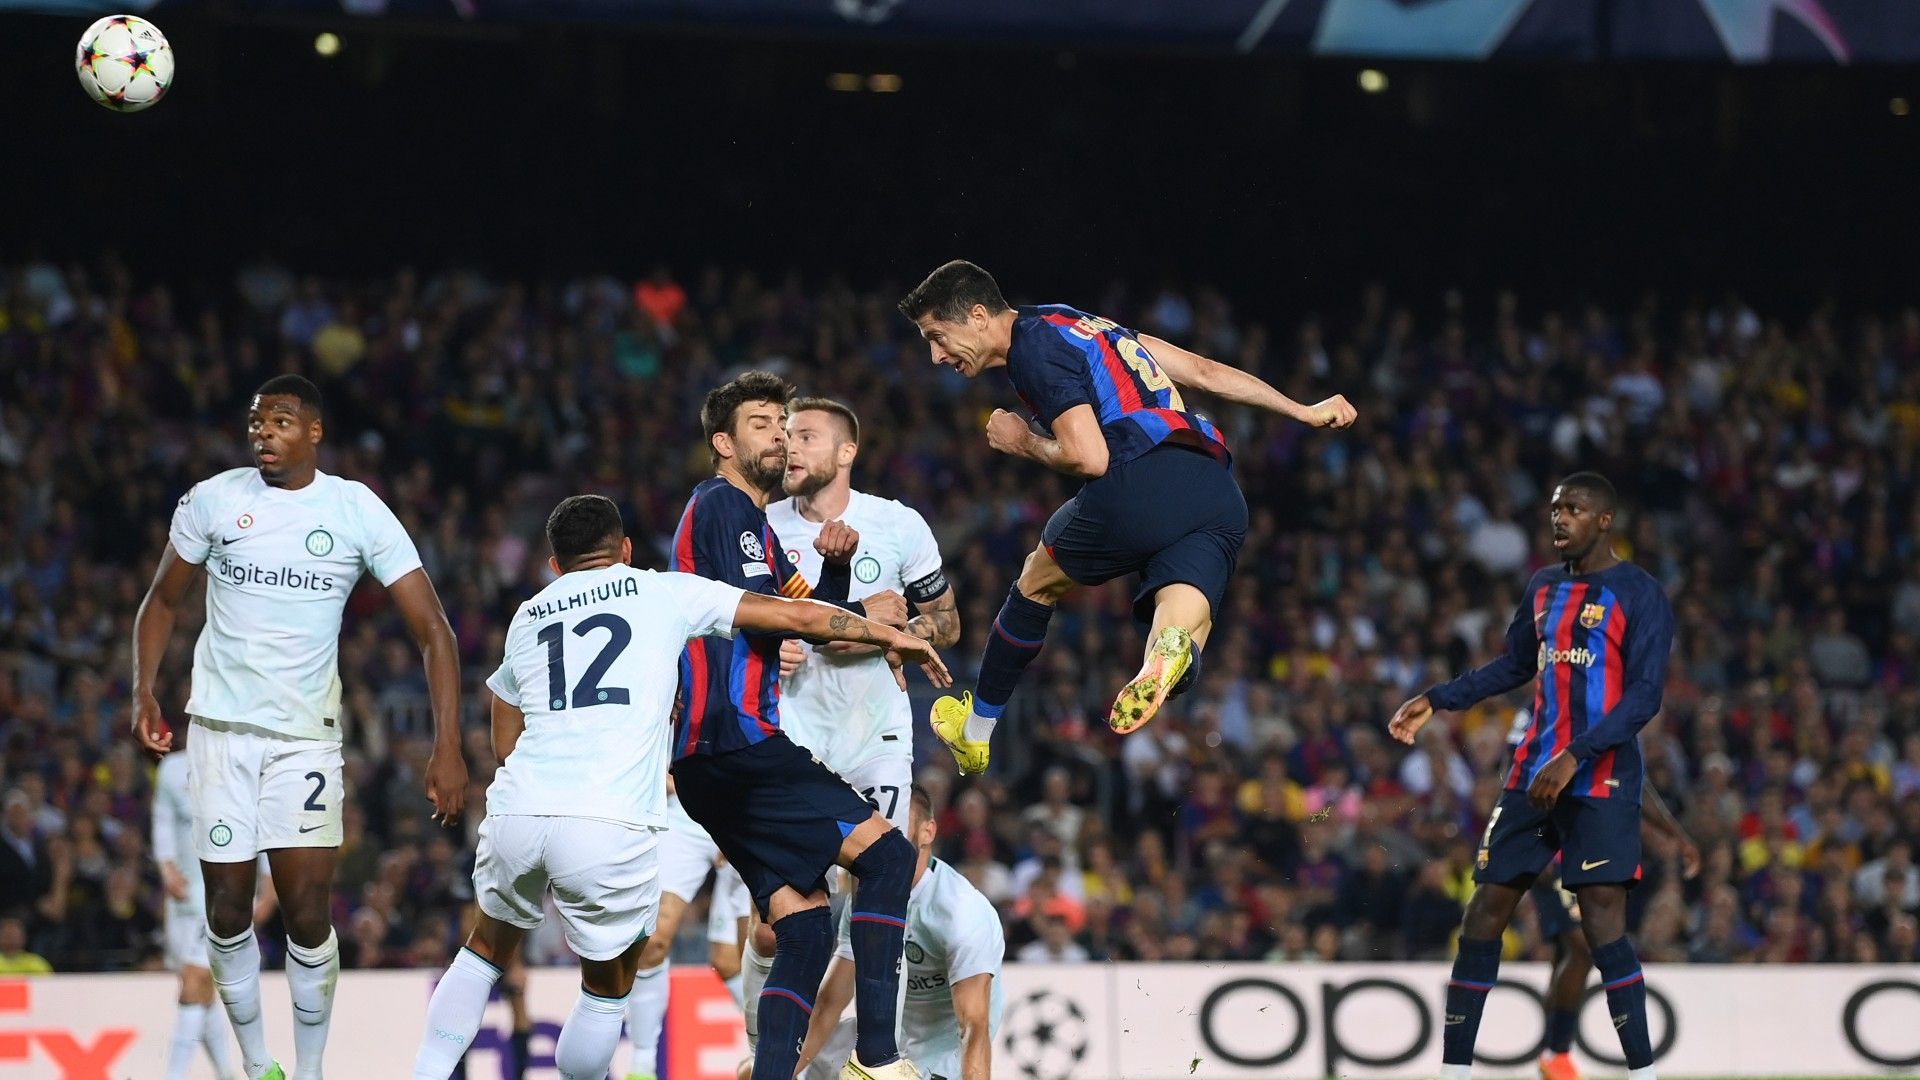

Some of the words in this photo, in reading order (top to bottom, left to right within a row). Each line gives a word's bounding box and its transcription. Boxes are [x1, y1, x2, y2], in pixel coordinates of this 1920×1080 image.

[220, 558, 333, 591] digitalbits
[537, 613, 632, 711] 12
[1547, 647, 1597, 668] Spotify
[304, 771, 326, 811] 2
[1200, 977, 1677, 1077] oppo
